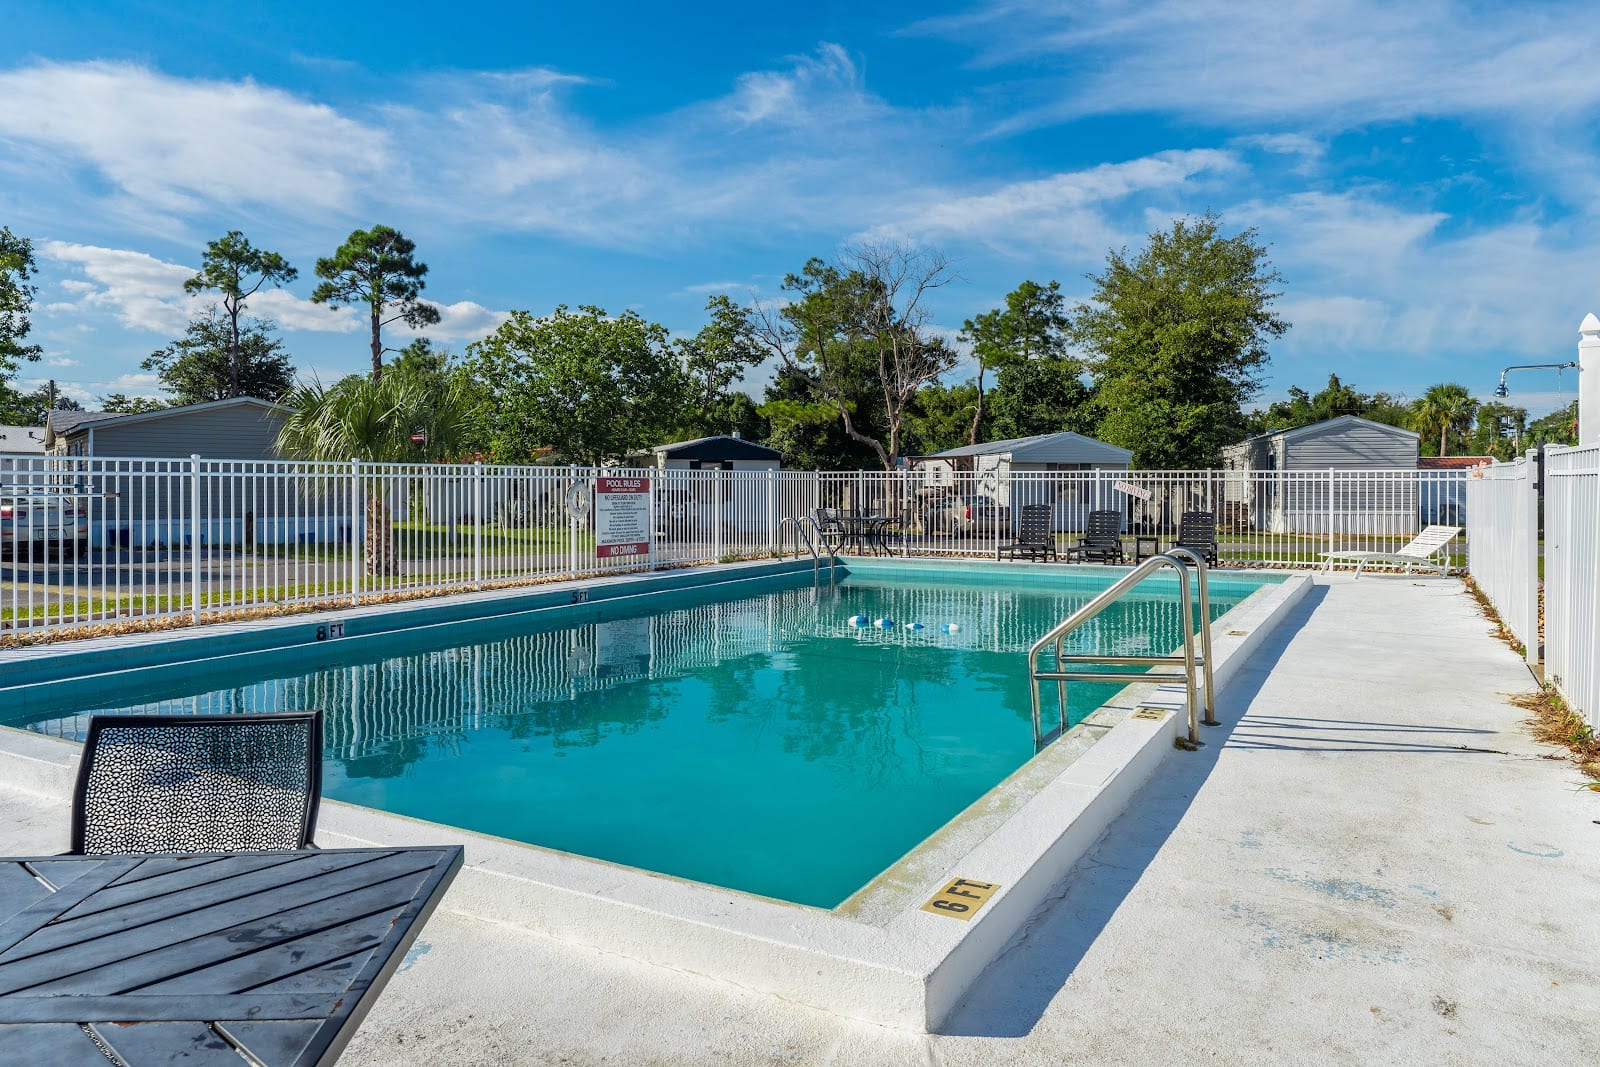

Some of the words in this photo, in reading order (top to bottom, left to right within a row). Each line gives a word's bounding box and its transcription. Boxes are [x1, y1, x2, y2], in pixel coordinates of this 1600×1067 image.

[606, 480, 622, 488] POOL
[623, 480, 641, 488] RULES
[610, 546, 620, 557] NO
[619, 544, 638, 556] DIVING
[316, 625, 327, 641] 8
[932, 899, 970, 913] 6
